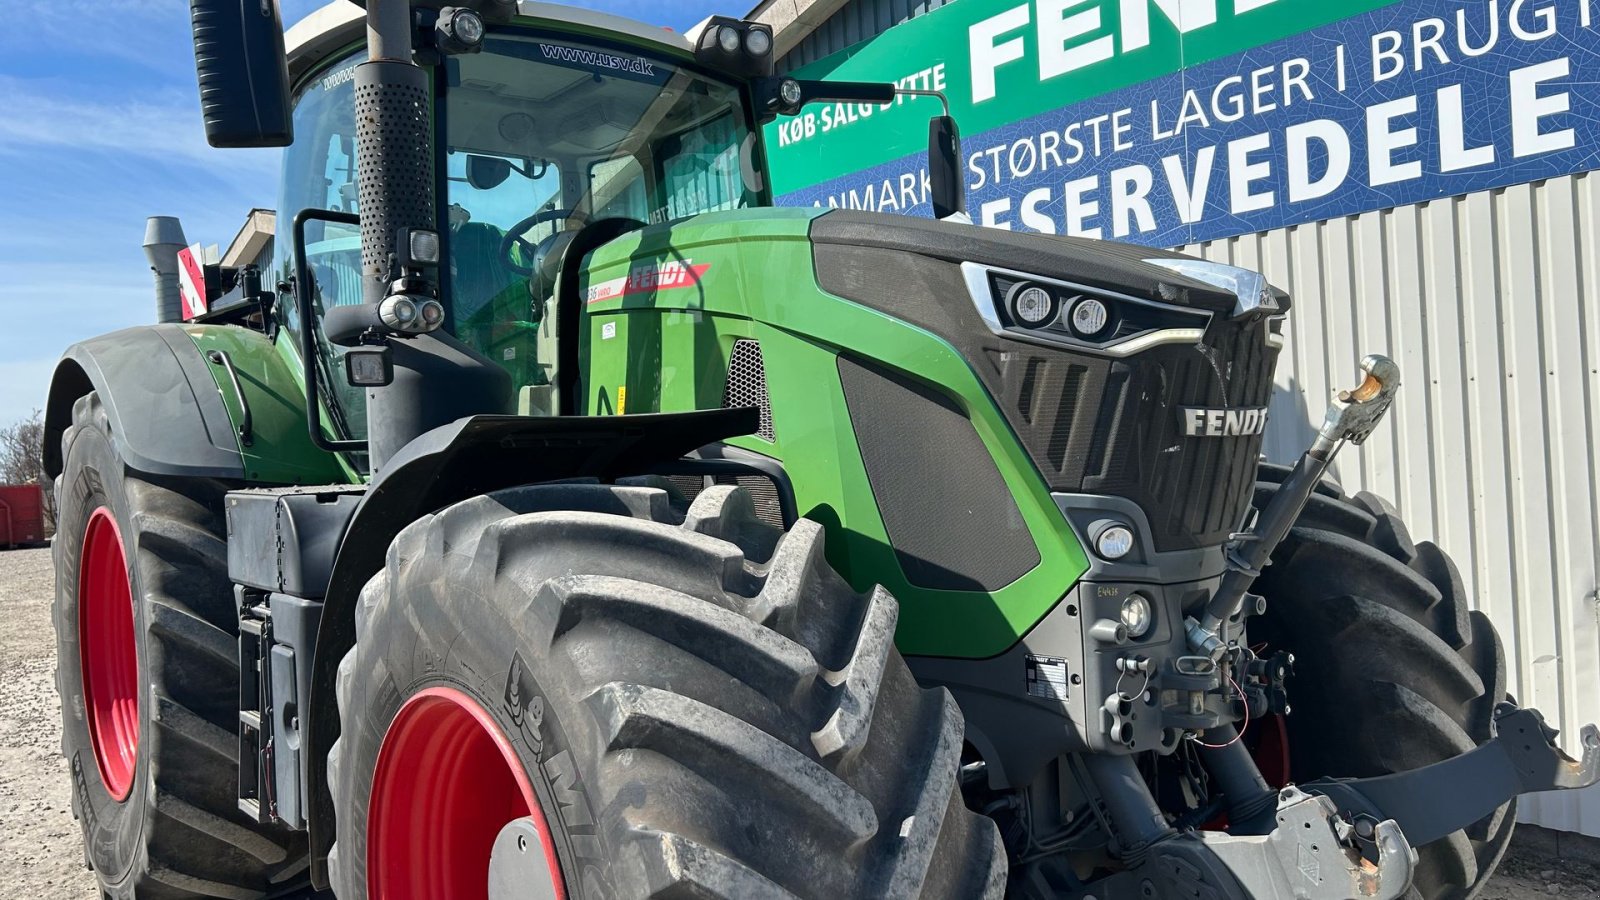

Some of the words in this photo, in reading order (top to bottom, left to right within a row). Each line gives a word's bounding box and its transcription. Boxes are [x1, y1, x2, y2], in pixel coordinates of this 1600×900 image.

[540, 44, 654, 76] www.usv.dk
[880, 63, 947, 112] YTTE
[968, 108, 1133, 190] STØRSTE
[1152, 57, 1314, 141] LAGER
[1336, 45, 1346, 92] I
[966, 57, 1575, 239] ESERVEDELE
[631, 259, 692, 289] FENDT
[1184, 407, 1268, 436] FENDT
